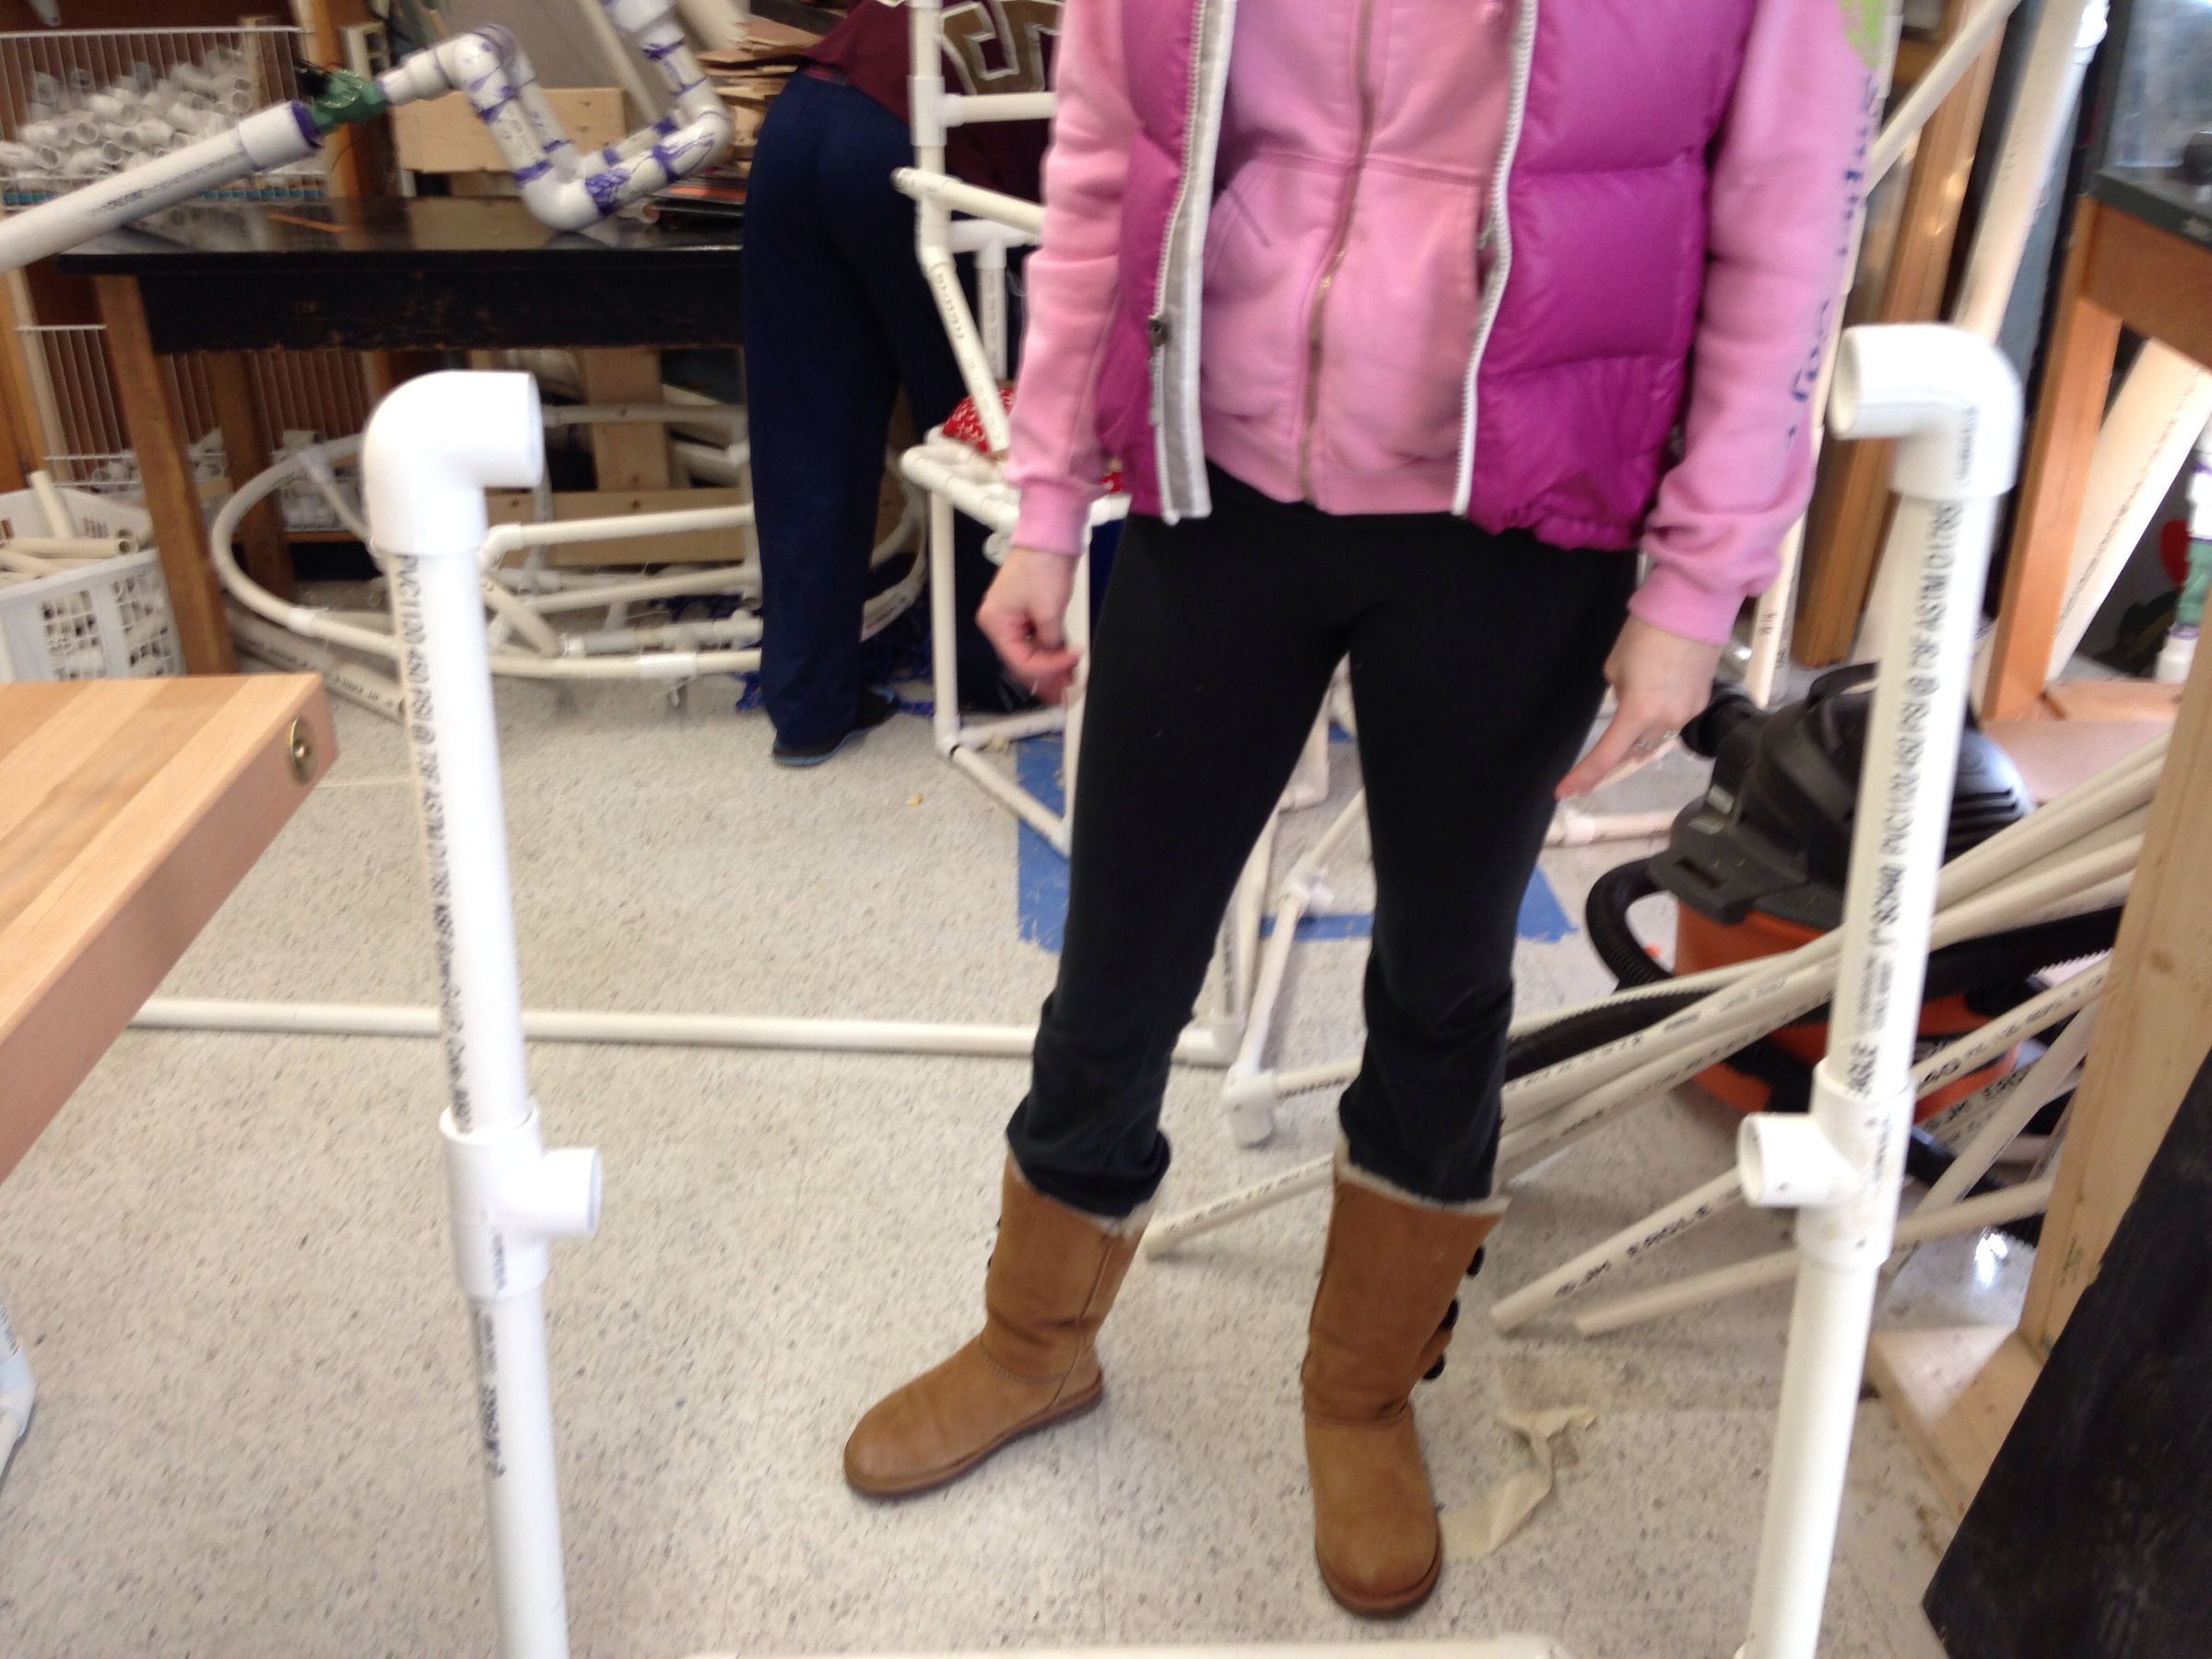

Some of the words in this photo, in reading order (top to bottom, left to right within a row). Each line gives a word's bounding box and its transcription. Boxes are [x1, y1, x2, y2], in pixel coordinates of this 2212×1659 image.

[1911, 571, 1950, 632] ASTM
[409, 687, 435, 723] PSI
[1895, 699, 1931, 735] PSI
[420, 786, 447, 841] ASTM
